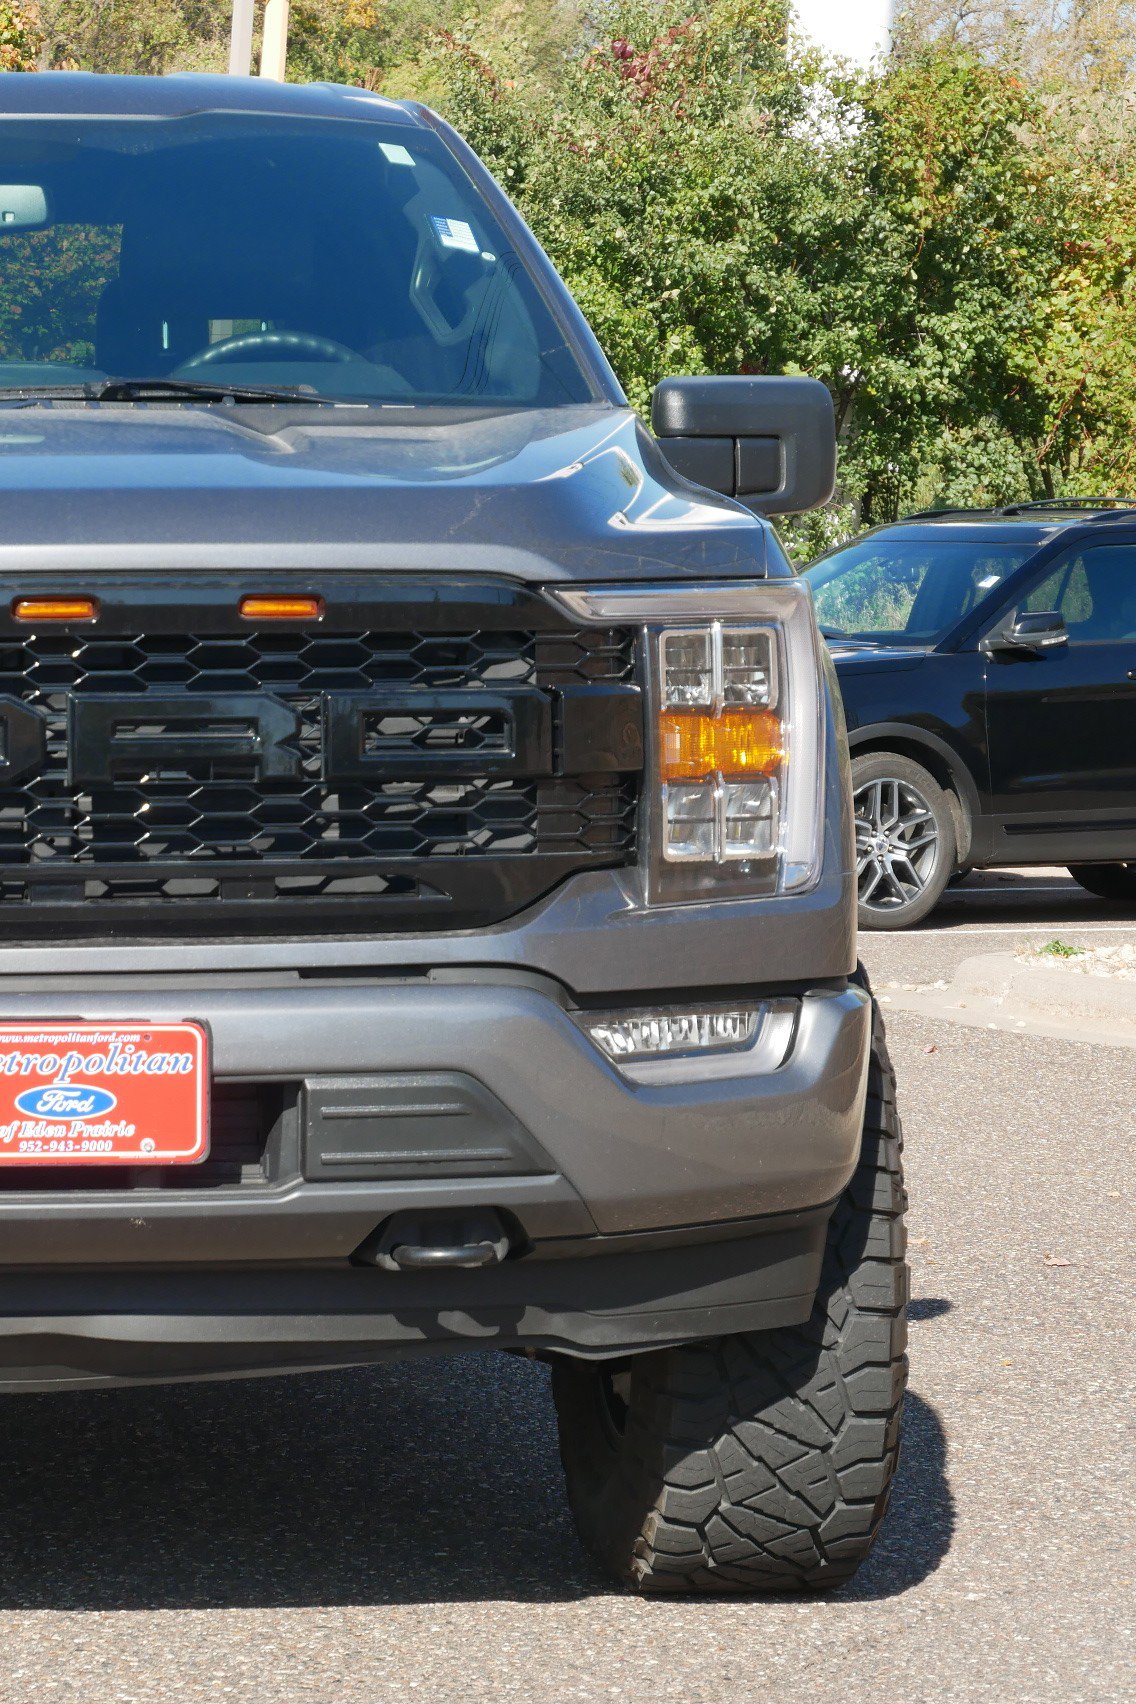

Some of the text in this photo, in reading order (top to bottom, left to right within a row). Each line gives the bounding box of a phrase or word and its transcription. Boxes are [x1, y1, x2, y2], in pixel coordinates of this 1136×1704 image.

[35, 1089, 96, 1113] Ford
[18, 1120, 67, 1138] Eden
[68, 1119, 136, 1138] Prairie
[18, 1140, 113, 1152] 952-943-9000
